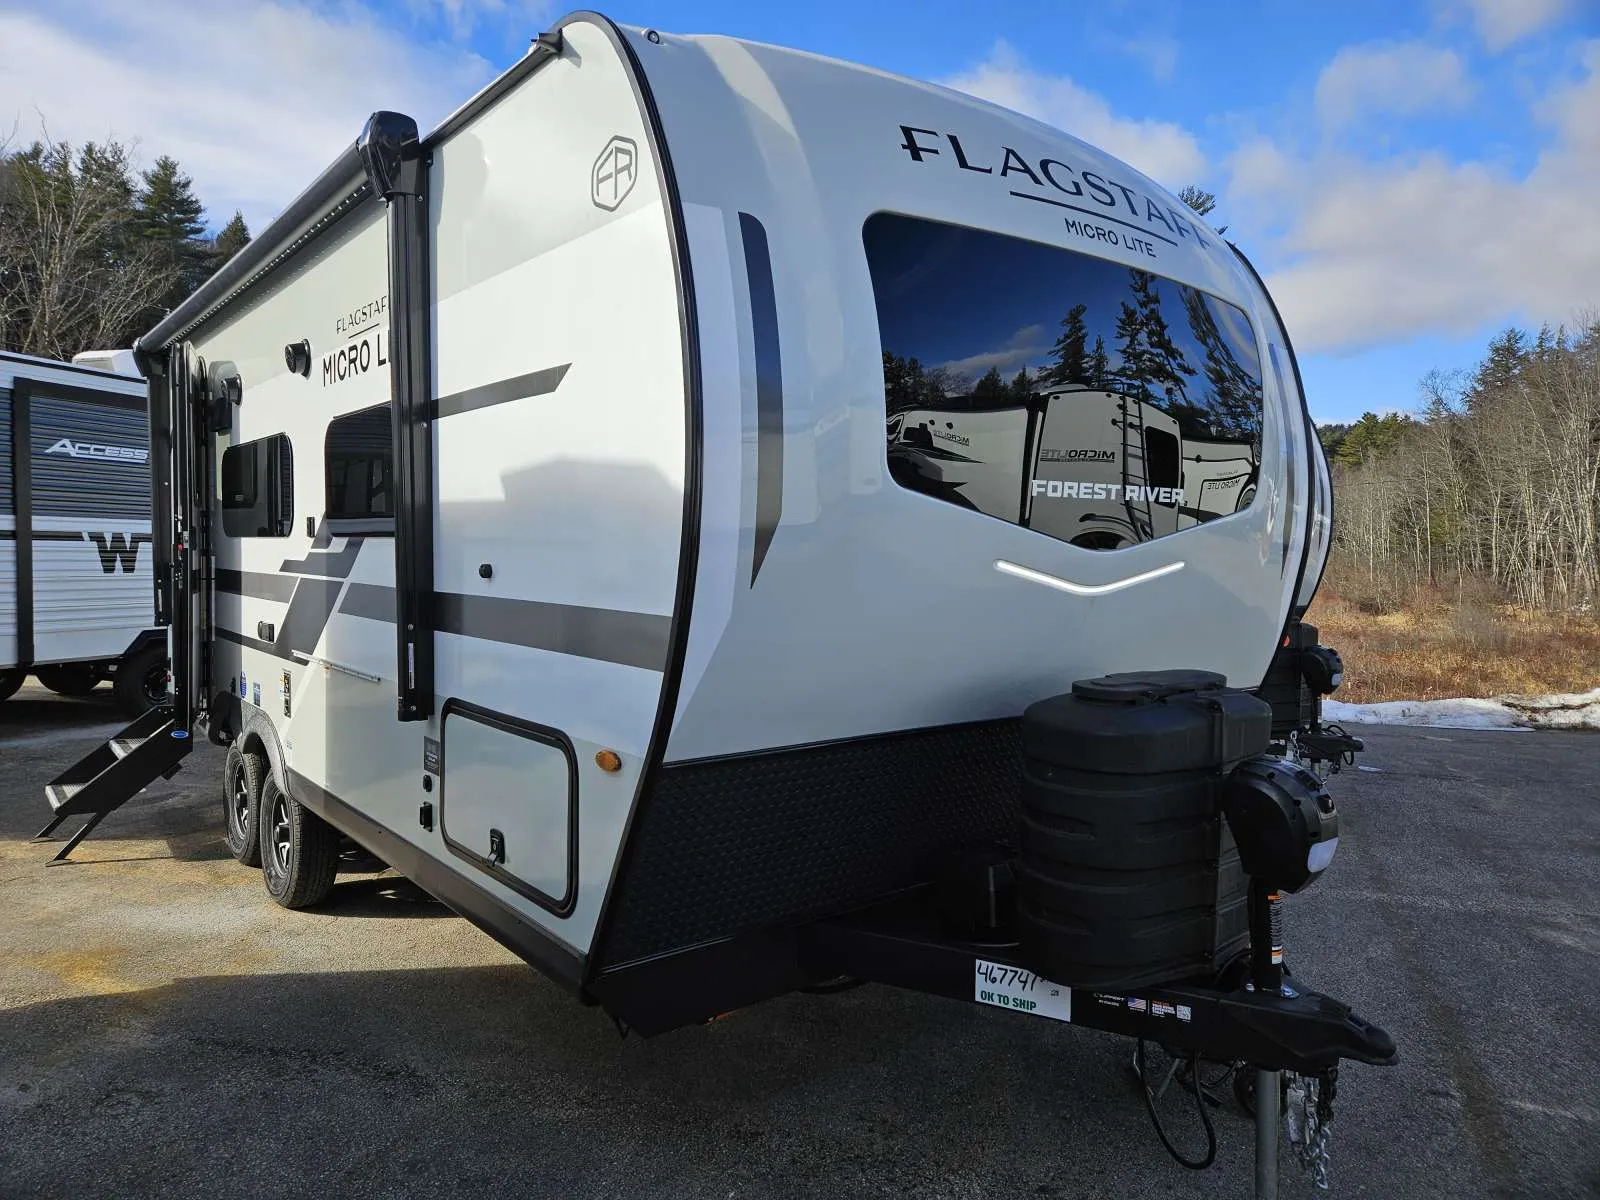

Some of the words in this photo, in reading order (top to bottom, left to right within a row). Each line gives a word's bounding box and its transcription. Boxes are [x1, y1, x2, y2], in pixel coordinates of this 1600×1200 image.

[899, 124, 1210, 250] FLAGSTAFF
[1065, 218, 1119, 246] MICRO
[1123, 234, 1157, 257] LITE
[336, 295, 388, 335] FLAGSTAF
[323, 339, 370, 387] MICRO
[44, 438, 149, 460] ACCESS
[1031, 479, 1122, 500] FOREST
[1125, 484, 1184, 503] RIVER
[83, 531, 143, 574] W
[980, 990, 995, 1003] OK
[997, 993, 1010, 1006] TO
[1012, 997, 1037, 1011] SHIP
